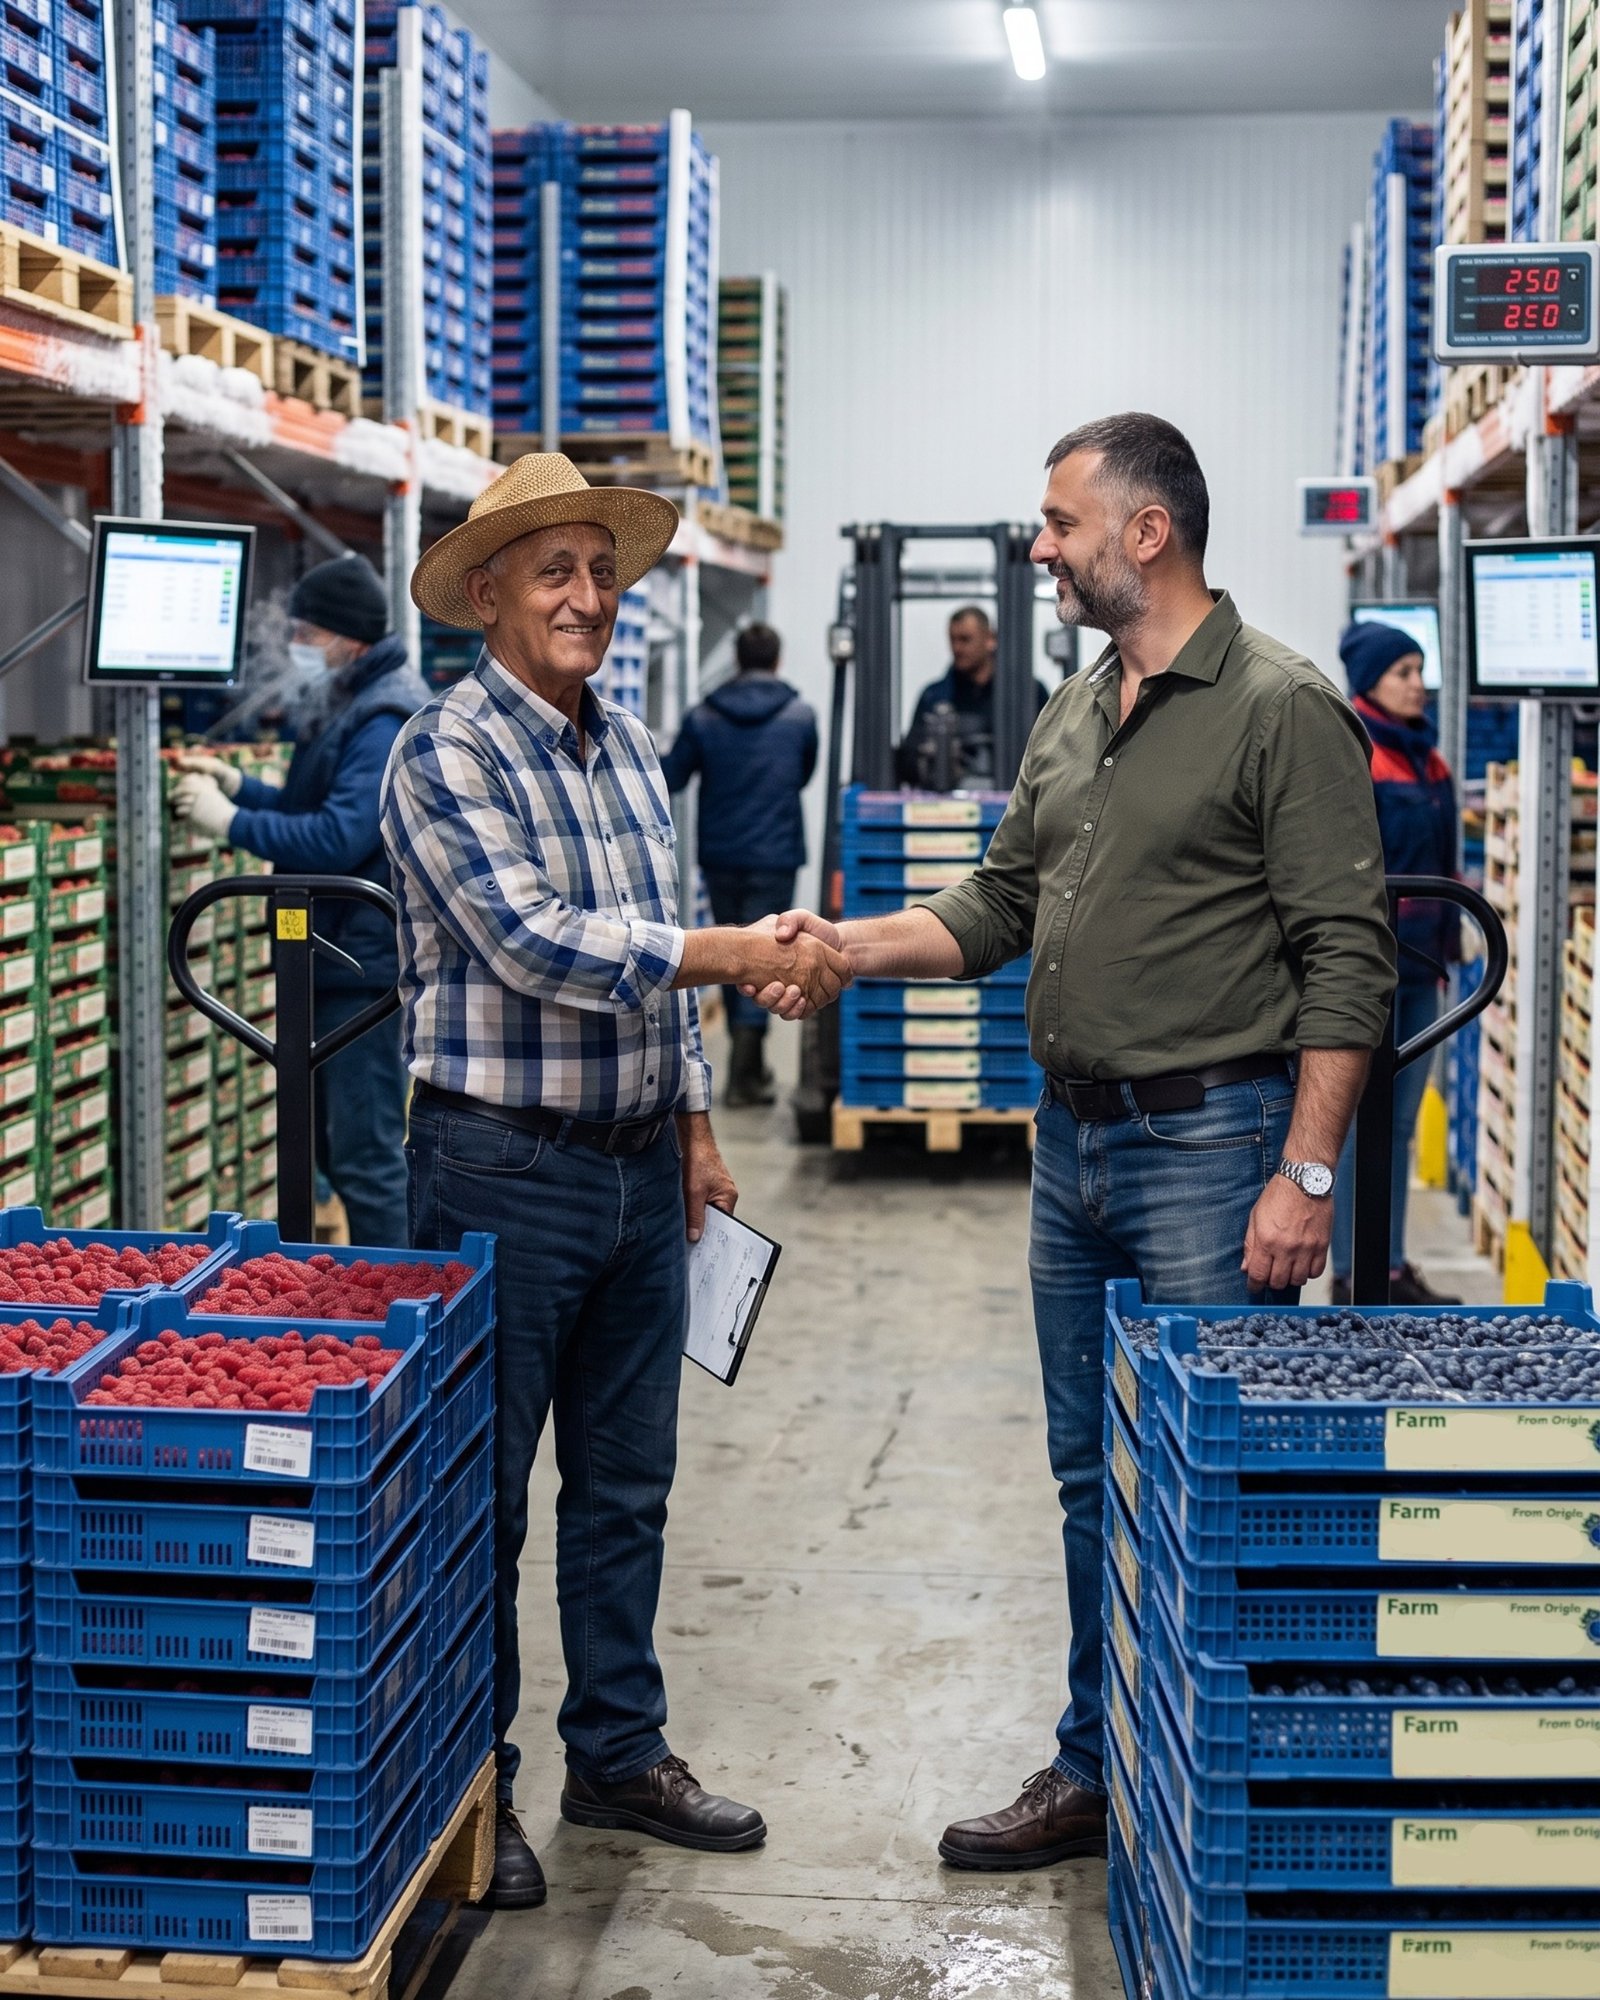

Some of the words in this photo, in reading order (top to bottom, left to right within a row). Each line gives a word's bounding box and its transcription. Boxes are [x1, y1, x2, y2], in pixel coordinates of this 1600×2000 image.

[1505, 268, 1560, 293] 250
[1504, 304, 1560, 329] 250
[1395, 1411, 1446, 1428] Farm
[1517, 1414, 1549, 1425] From
[1551, 1415, 1589, 1428] Origin
[1389, 1502, 1441, 1519] Farm
[1512, 1507, 1543, 1517] From
[1387, 1598, 1439, 1615] Farm
[1510, 1602, 1541, 1613] From
[1403, 1715, 1458, 1733] Farm
[1538, 1717, 1572, 1728] From
[1574, 1717, 1600, 1731] Orig
[1403, 1823, 1458, 1841] Farm
[1536, 1825, 1570, 1837] From
[1573, 1826, 1600, 1839] Orig
